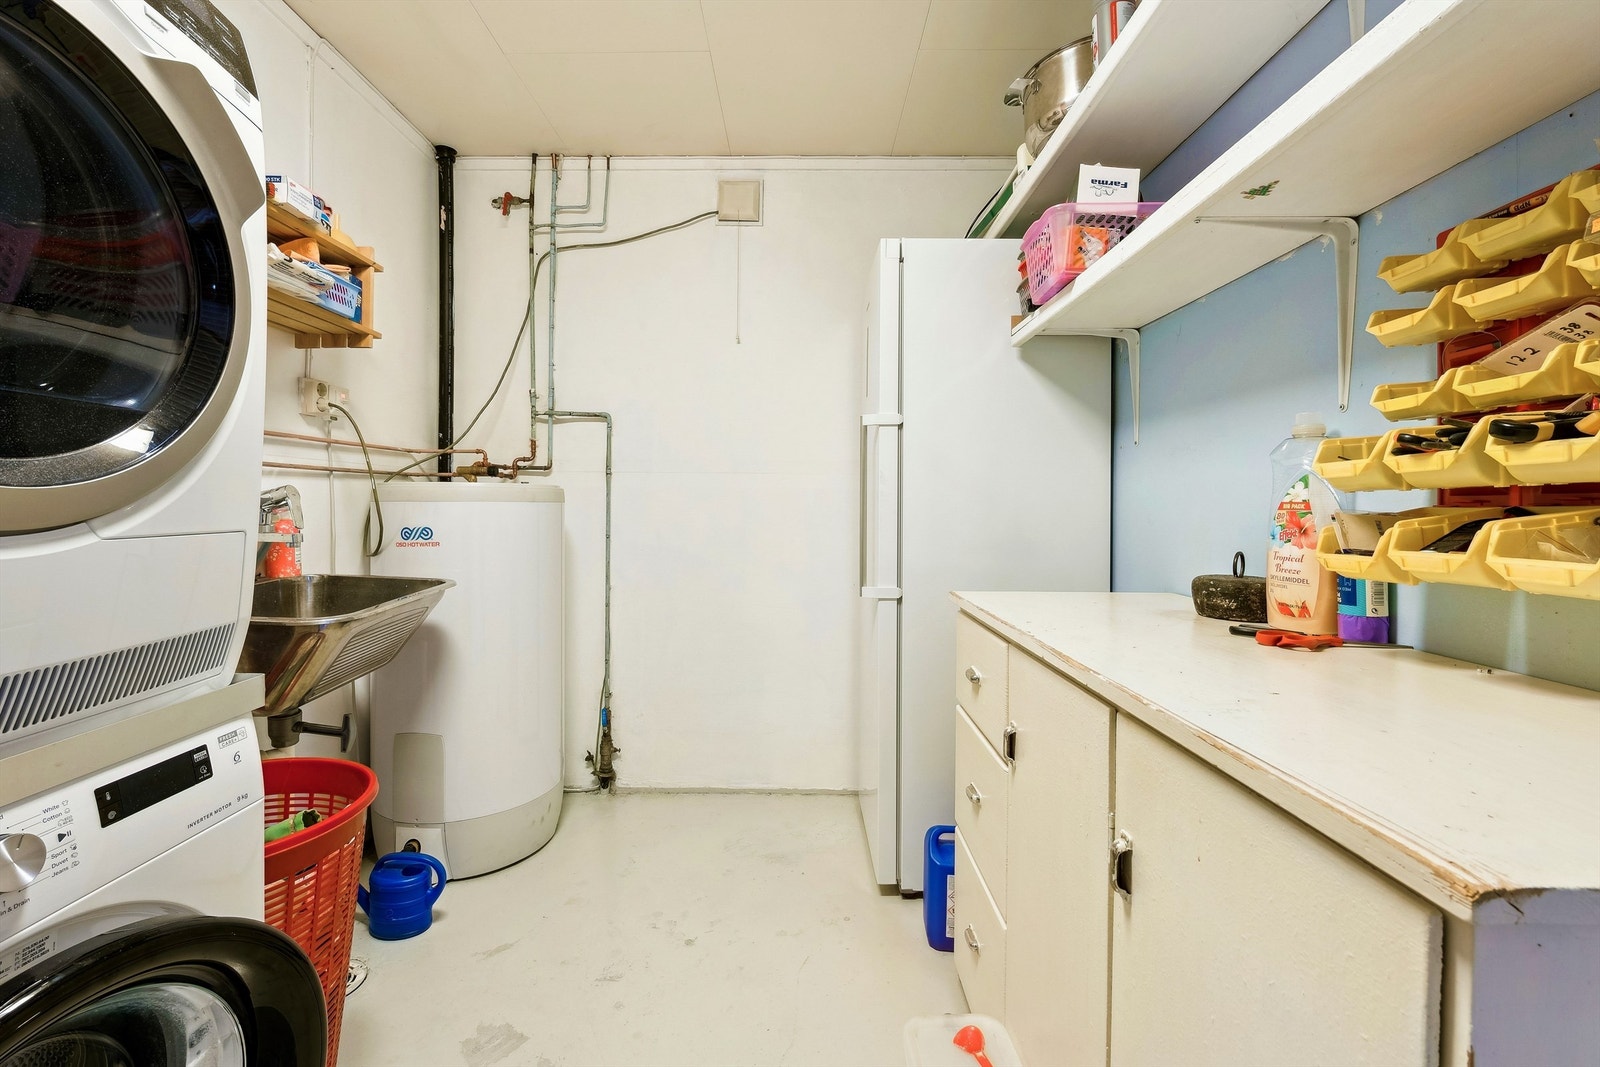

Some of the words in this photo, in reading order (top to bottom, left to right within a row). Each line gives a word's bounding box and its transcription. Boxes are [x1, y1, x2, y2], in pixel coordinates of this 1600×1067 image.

[1091, 179, 1128, 188] Farma
[1273, 551, 1305, 564] Tropical
[1275, 563, 1302, 575] Breeze
[42, 804, 60, 814] White
[42, 813, 63, 823] Cotton
[187, 810, 214, 829] INVERTER
[213, 802, 232, 815] MOTOR
[51, 848, 67, 860] Sport
[51, 857, 69, 869] Duvet
[51, 866, 69, 878] Jeans
[13, 897, 31, 910] Drain
